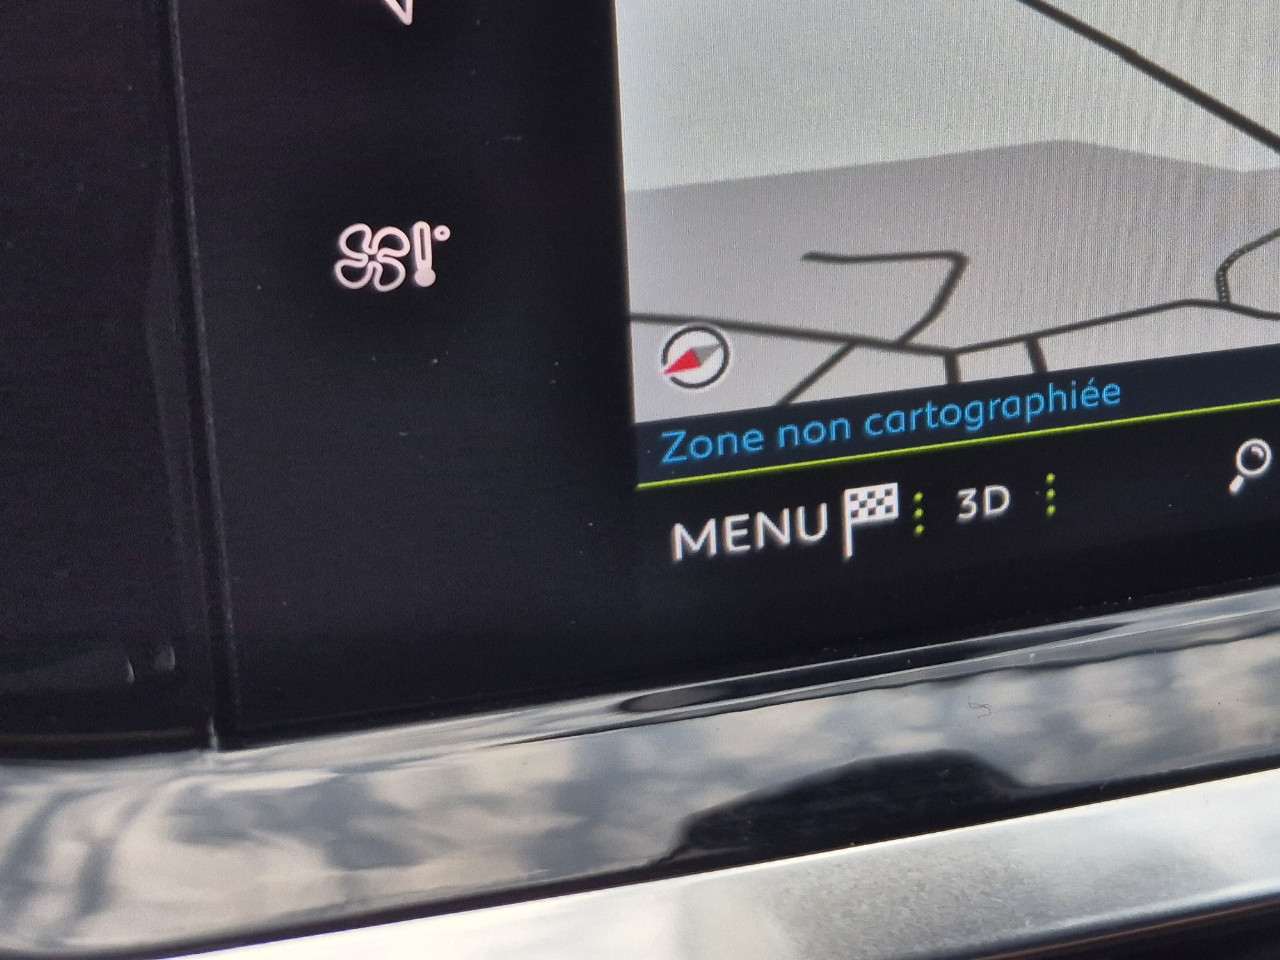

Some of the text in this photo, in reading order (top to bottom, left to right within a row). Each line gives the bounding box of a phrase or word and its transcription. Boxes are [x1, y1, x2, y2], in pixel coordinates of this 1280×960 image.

[661, 377, 1122, 464] Zone non cartographiée
[671, 503, 830, 562] MENU
[956, 485, 1012, 522] 3D
